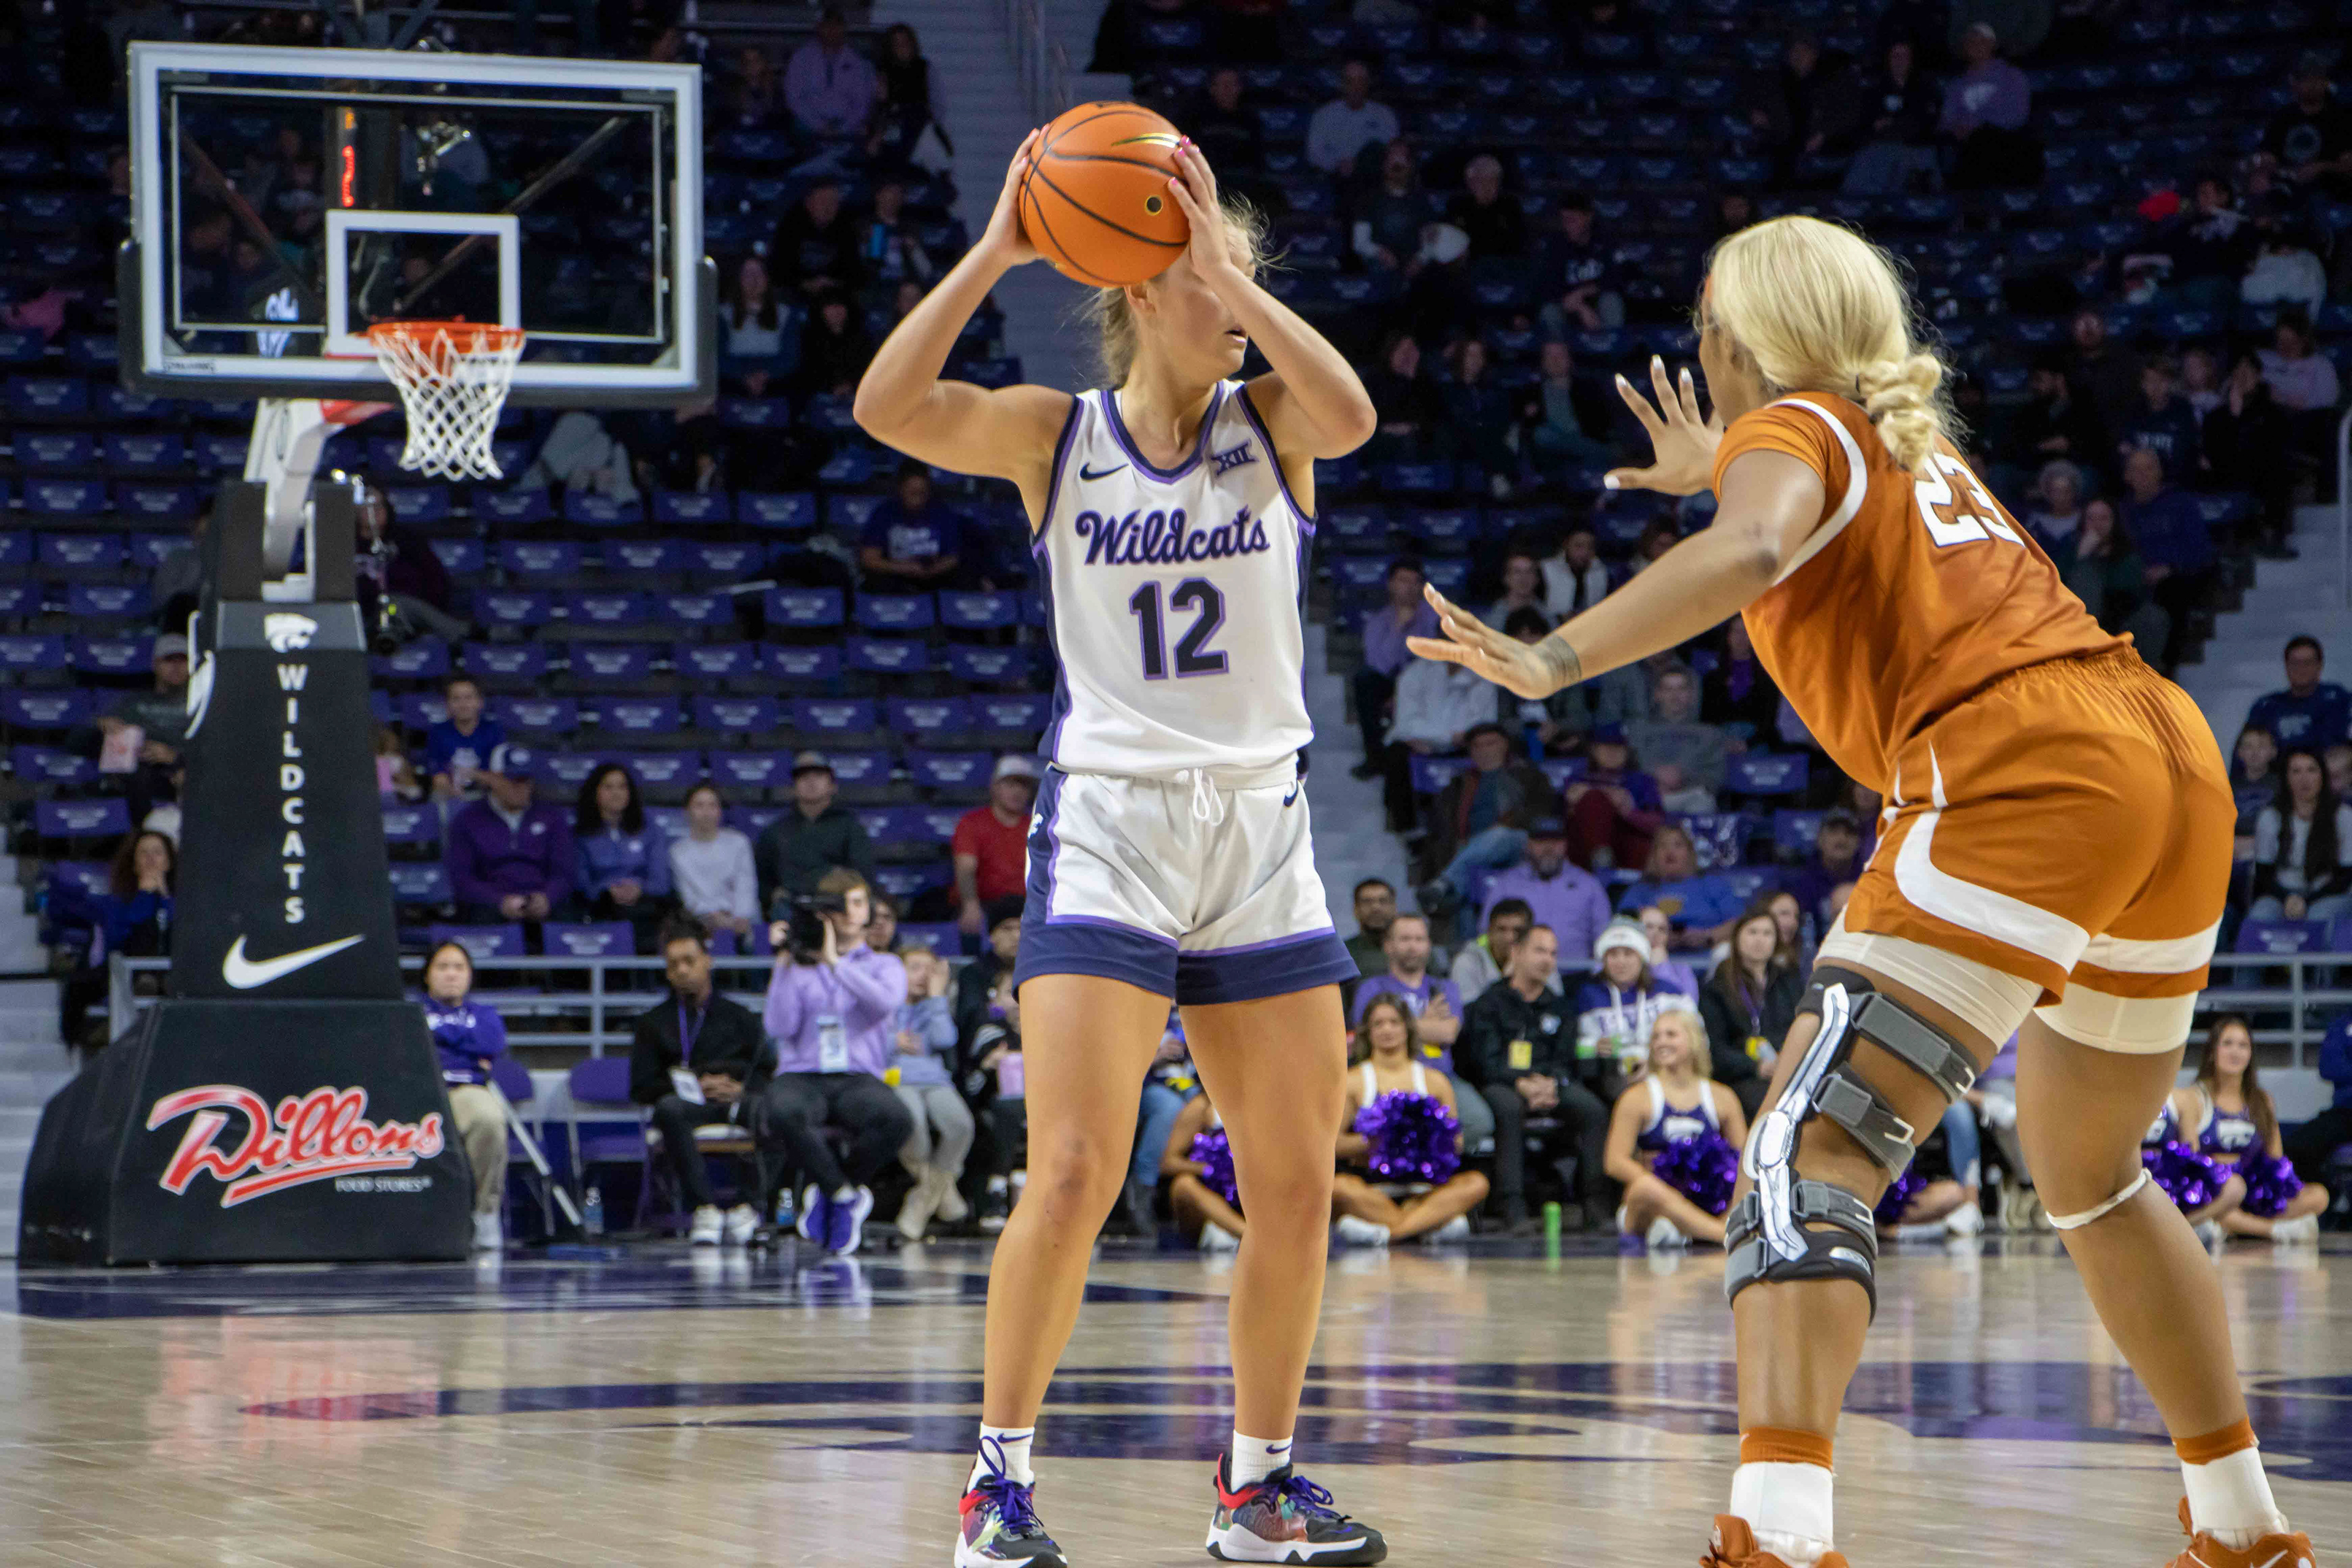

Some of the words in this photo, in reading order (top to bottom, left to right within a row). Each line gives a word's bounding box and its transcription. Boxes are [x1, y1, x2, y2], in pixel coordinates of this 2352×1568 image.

[1211, 438, 1259, 478] XII
[1914, 452, 2027, 548] 23
[1075, 504, 1271, 566] Wildcats
[1129, 577, 1229, 680] 12
[277, 663, 309, 924] WILDCATS
[146, 1084, 445, 1196] Dillons
[335, 1176, 374, 1192] FOOD
